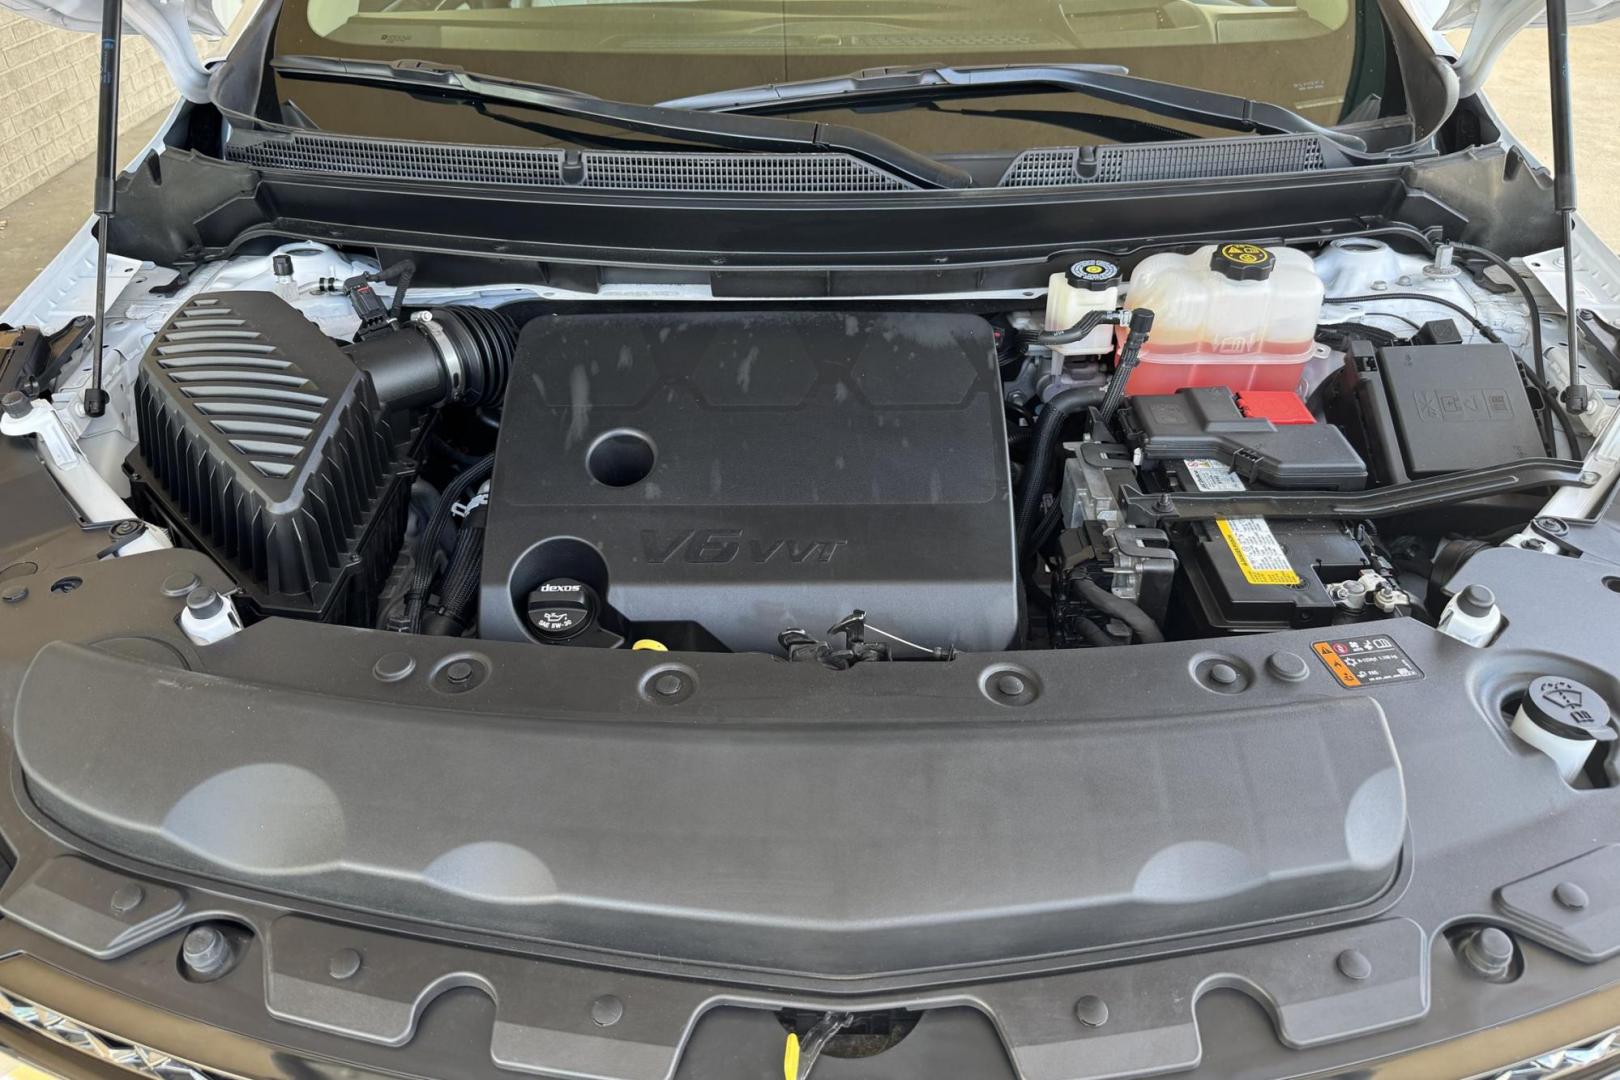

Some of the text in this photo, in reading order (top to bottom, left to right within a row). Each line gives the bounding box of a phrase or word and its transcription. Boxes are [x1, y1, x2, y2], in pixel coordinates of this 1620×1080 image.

[640, 528, 848, 564] V6 VVT
[540, 583, 581, 592] dexos
